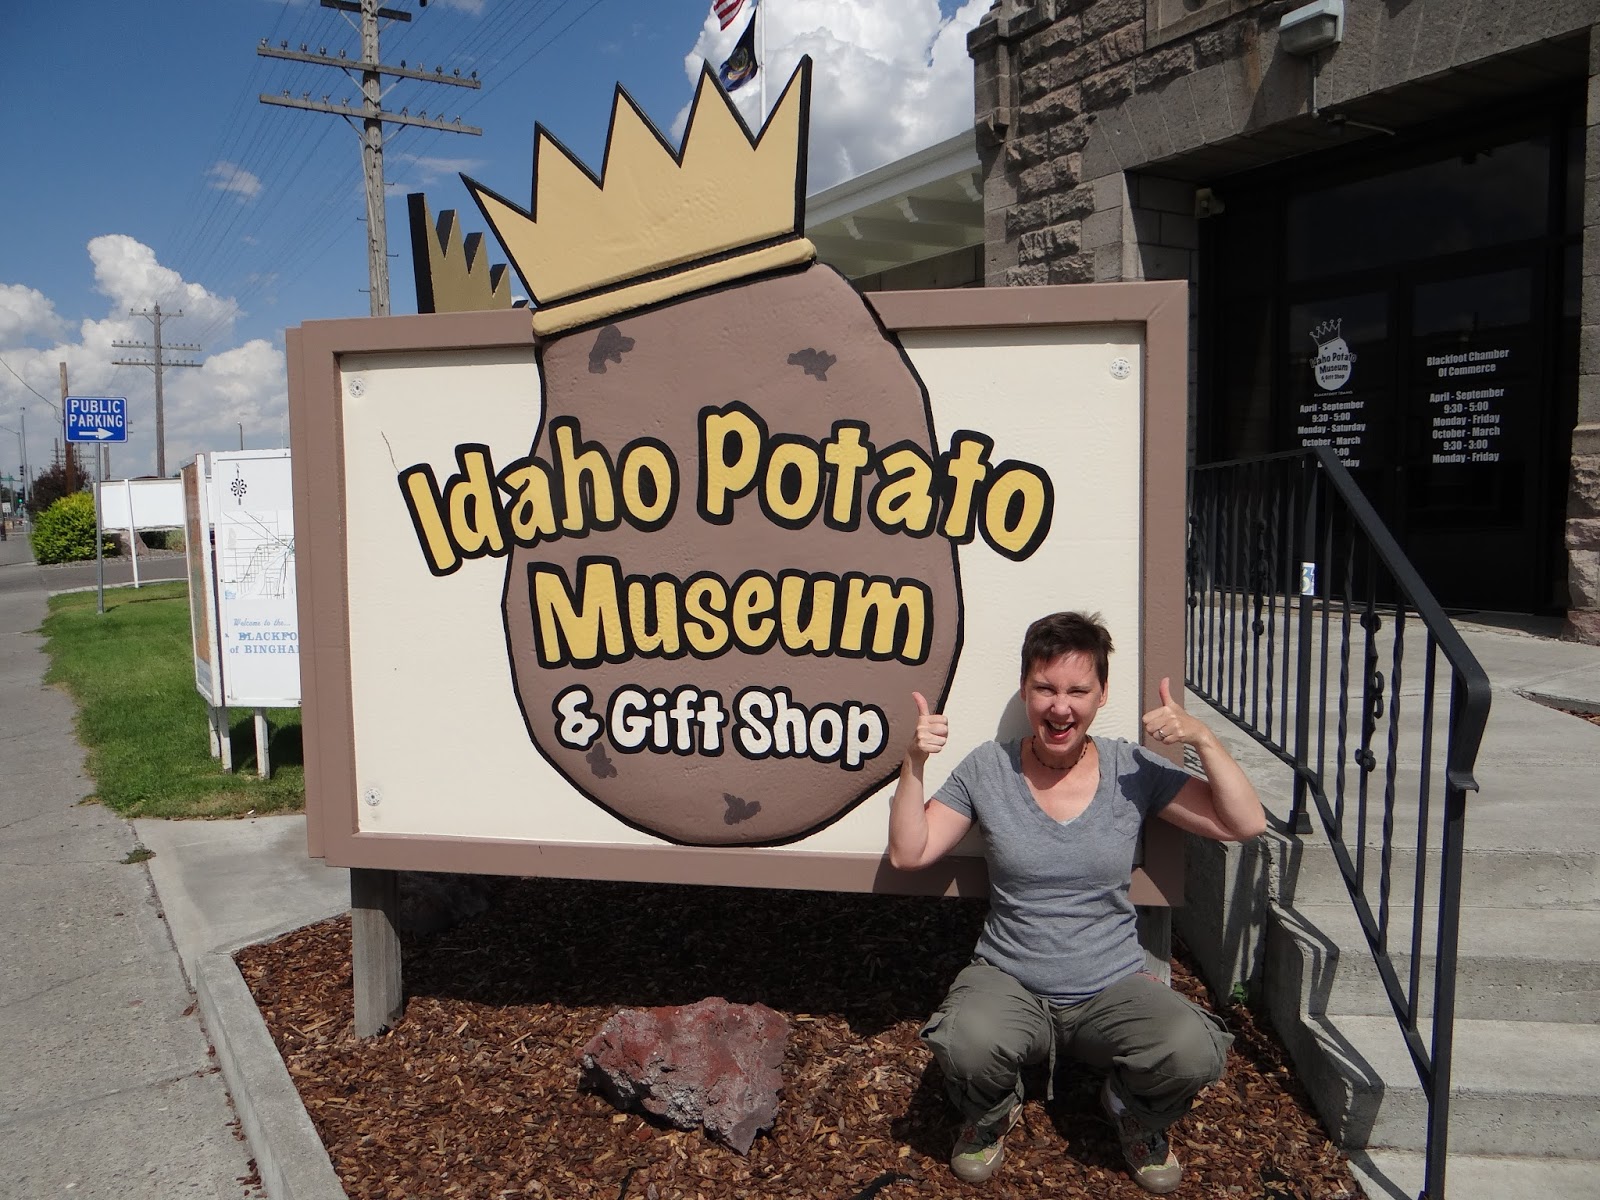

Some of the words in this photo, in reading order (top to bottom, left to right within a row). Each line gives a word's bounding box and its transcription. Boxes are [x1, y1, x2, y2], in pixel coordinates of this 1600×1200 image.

[1427, 354, 1468, 366] Blackfoot
[1468, 350, 1510, 362] Chamber
[1319, 364, 1349, 374] Museum
[1438, 367, 1448, 377] Of
[1448, 364, 1496, 376] Commerce
[1430, 392, 1450, 403] April
[1456, 388, 1504, 400] September
[70, 400, 120, 414] PUBLIC
[1300, 404, 1318, 413] April
[1322, 401, 1364, 412] September
[1444, 404, 1462, 414] 9:30
[1469, 402, 1488, 412] 5:00
[70, 414, 122, 427] PARKING
[1312, 414, 1328, 422] 9:30
[1334, 412, 1350, 422] 5:00
[1433, 416, 1466, 426] Monday
[1472, 414, 1500, 424] Friday
[1298, 426, 1326, 434] Monday
[1331, 423, 1366, 432] Saturday
[1432, 429, 1466, 439] October
[1472, 426, 1500, 436] March
[1302, 438, 1331, 446] October
[1336, 436, 1361, 446] March
[1443, 441, 1462, 450] 9:30
[1468, 440, 1488, 450] 3:00
[1432, 454, 1466, 464] Monday
[1472, 452, 1500, 462] Friday
[398, 415, 680, 577] Idaho
[697, 400, 1054, 562] Potato
[527, 555, 934, 669] Museum
[233, 618, 260, 626] Welcome
[230, 646, 240, 654] of
[552, 684, 605, 751] &
[606, 684, 725, 757] Gift
[731, 686, 889, 771] Shop
